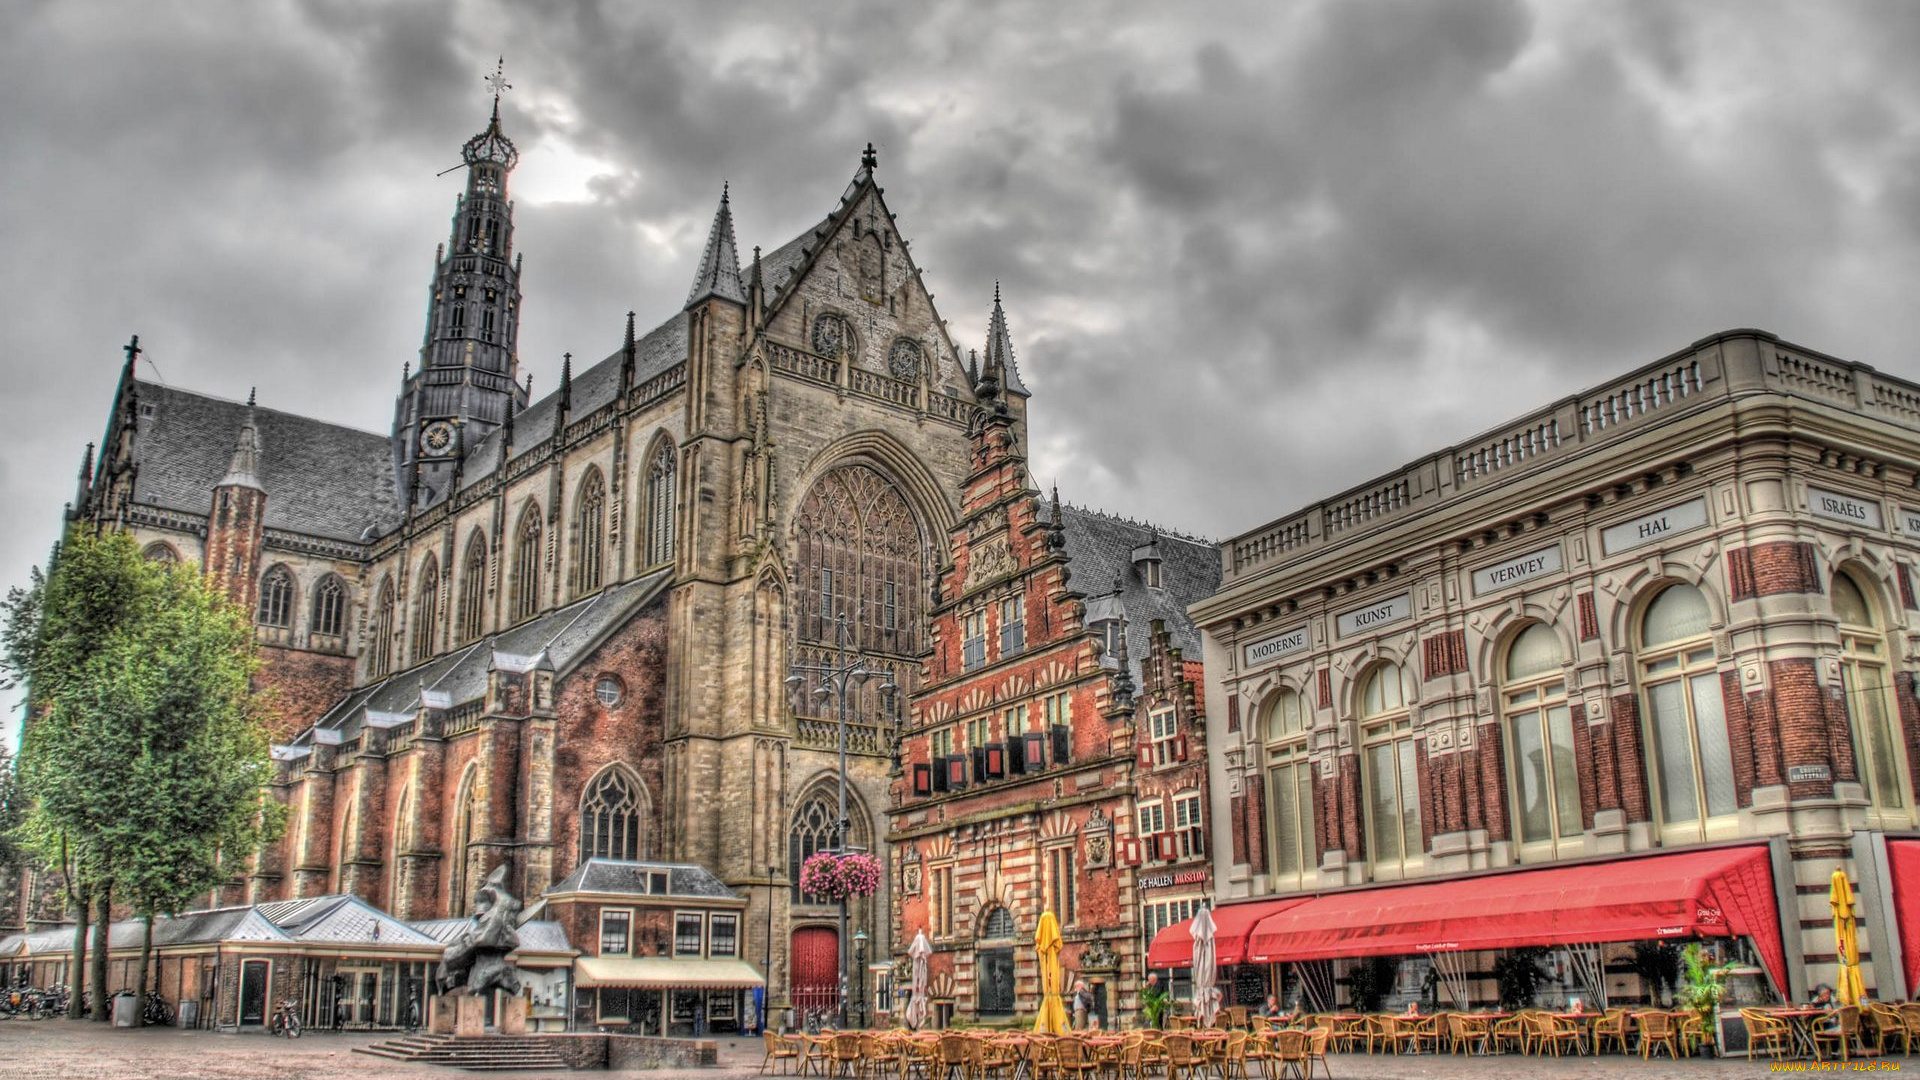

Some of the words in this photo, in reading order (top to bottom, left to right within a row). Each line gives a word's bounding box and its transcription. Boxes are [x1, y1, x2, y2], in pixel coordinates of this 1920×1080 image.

[1821, 497, 1866, 520] ISRAËLS
[1638, 516, 1671, 538] HAL
[1490, 556, 1545, 585] VERWEY
[1355, 604, 1393, 627] KUNST
[1252, 633, 1303, 660] MODERNE
[1138, 878, 1147, 889] DE
[1148, 875, 1173, 888] HALLEN
[1174, 871, 1206, 885] MUSEUM
